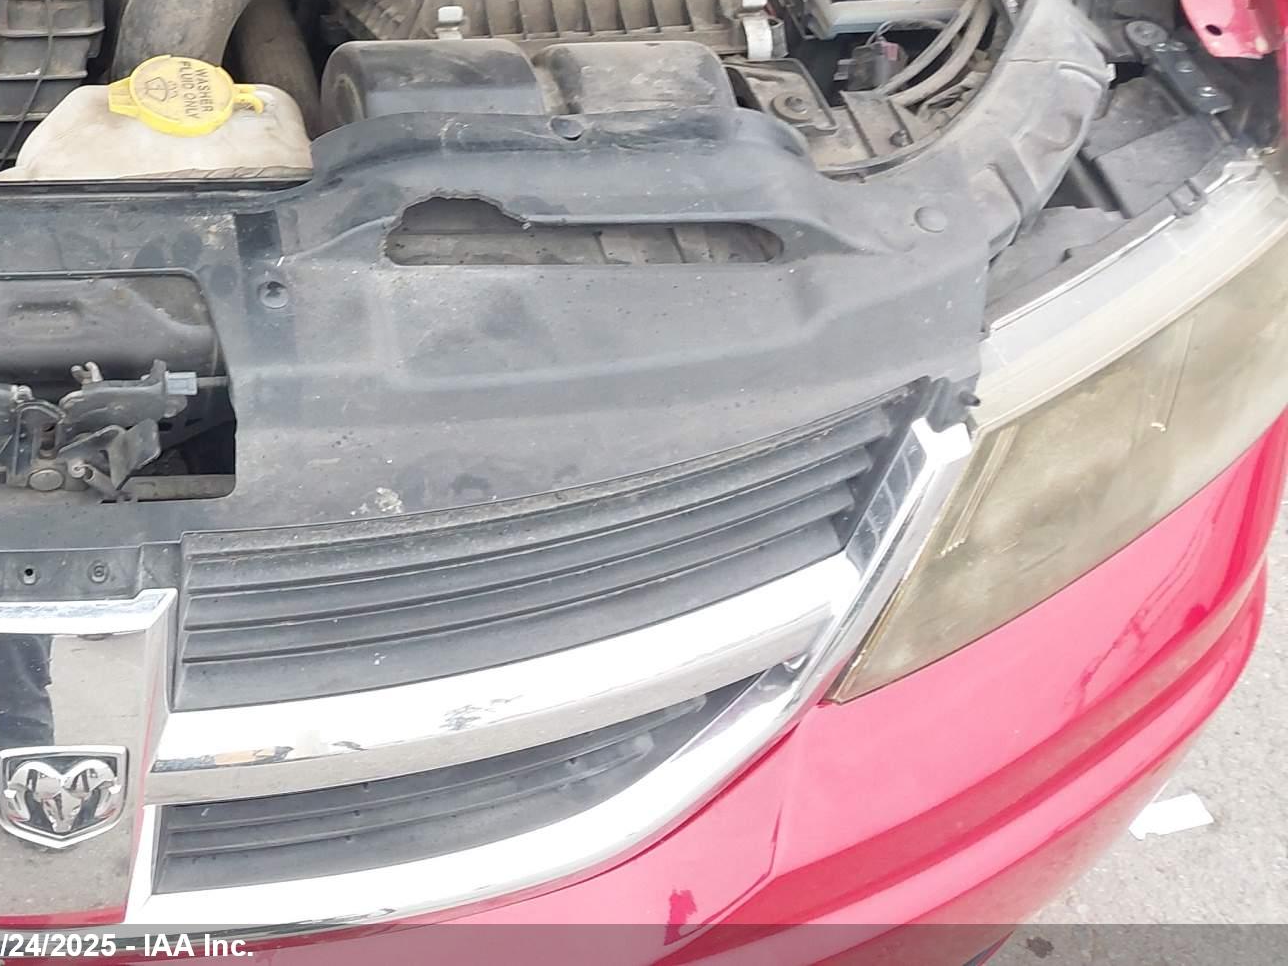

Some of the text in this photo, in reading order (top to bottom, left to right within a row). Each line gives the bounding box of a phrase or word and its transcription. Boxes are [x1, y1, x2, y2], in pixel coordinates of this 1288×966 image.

[178, 60, 201, 120] FLUID ONLY
[194, 68, 215, 113] WASHER
